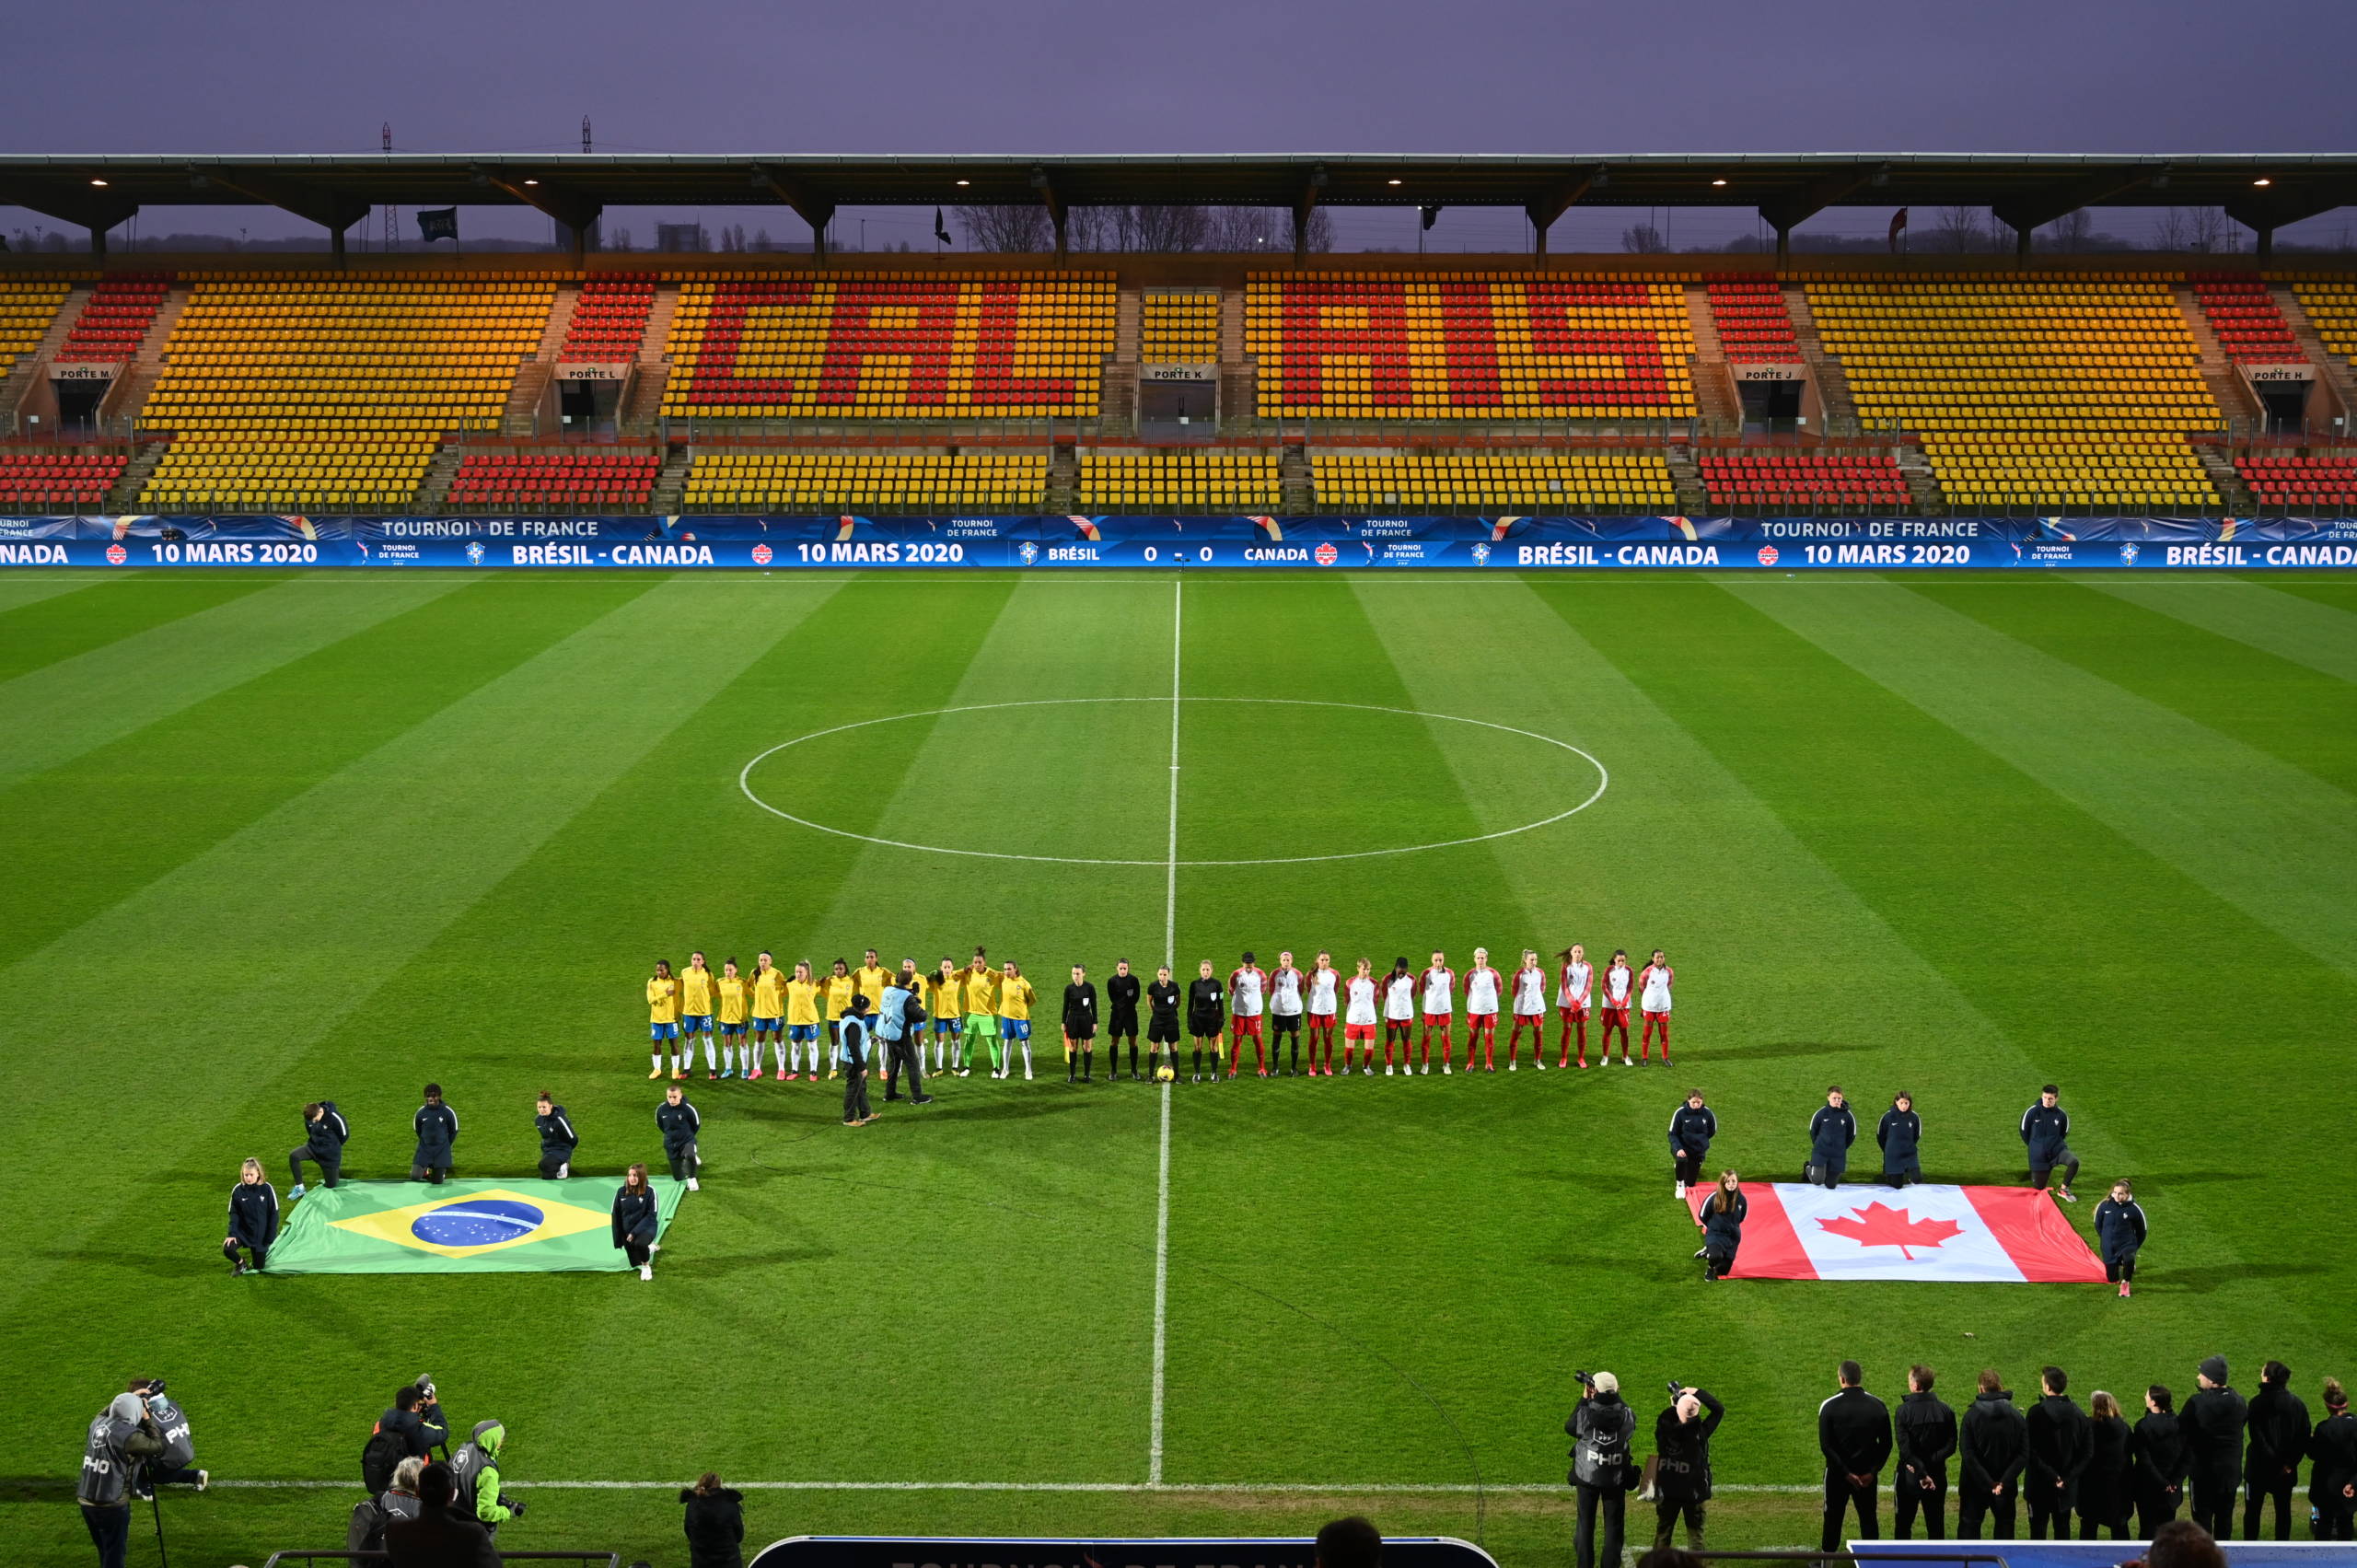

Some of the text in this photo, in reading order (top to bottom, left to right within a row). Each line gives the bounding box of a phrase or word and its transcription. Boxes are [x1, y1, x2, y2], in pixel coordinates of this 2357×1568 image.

[382, 521, 598, 536] TOURNOI DE FRANCE
[952, 519, 993, 528] TOURNOI
[1761, 522, 1979, 537] TOURNOI DE FRANCE
[946, 528, 998, 537] DE FRANCE
[1361, 528, 1412, 537] DE FRANCE
[2328, 530, 2340, 539] DE
[153, 543, 318, 563] 10 MARS 2020
[512, 541, 594, 564] BRÉSIL
[611, 544, 714, 564] CANADA
[797, 543, 964, 563] 10 MARS 2020
[1048, 544, 1100, 561] BRÉSIL
[1144, 546, 1157, 562] 0
[1200, 546, 1213, 562] 0
[1244, 548, 1308, 561] CANADA
[1518, 541, 1599, 565] BRÉSIL
[1618, 545, 1720, 564] CANADA
[1805, 545, 1970, 563] 10 MARS 2020
[2166, 542, 2247, 565] BRÉSIL
[1020, 1023, 1028, 1032] 10
[1587, 1449, 1623, 1466] PHO
